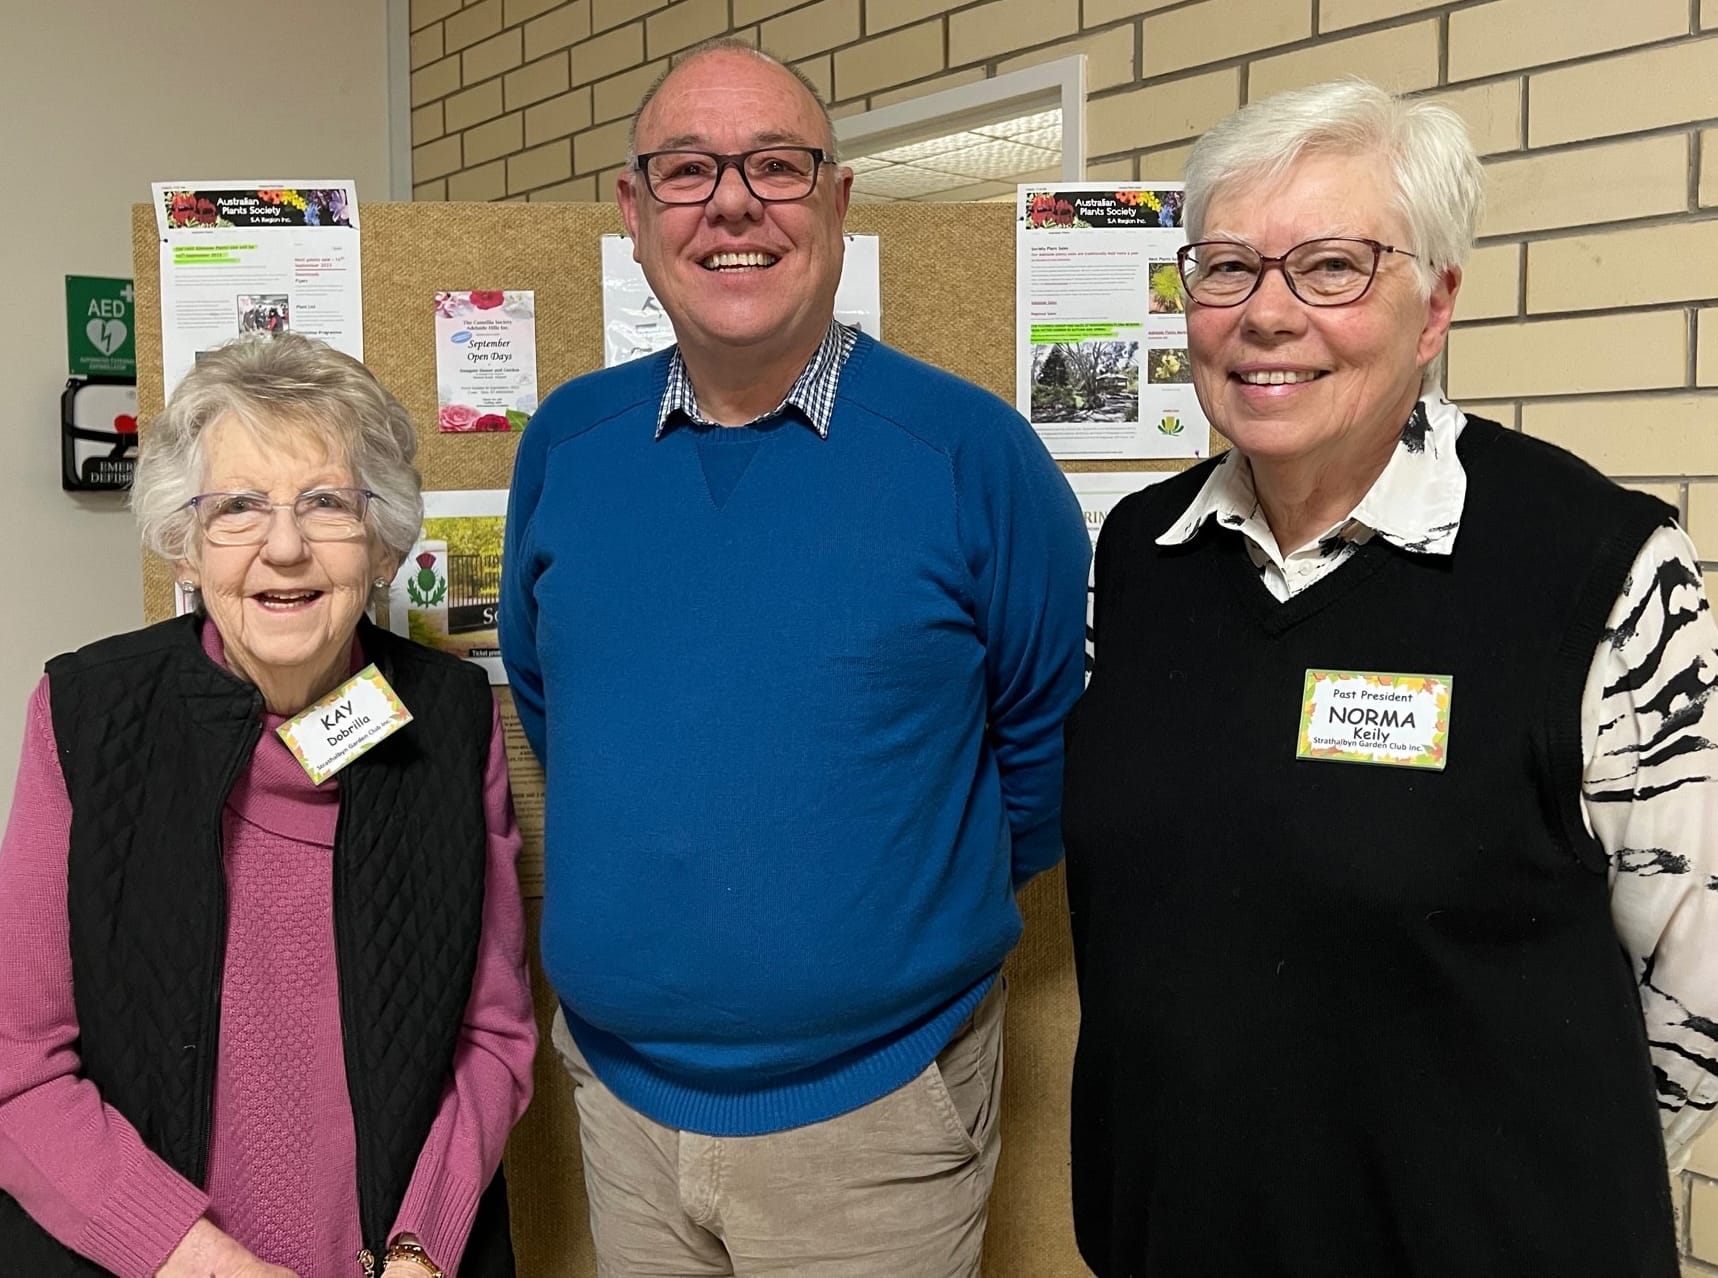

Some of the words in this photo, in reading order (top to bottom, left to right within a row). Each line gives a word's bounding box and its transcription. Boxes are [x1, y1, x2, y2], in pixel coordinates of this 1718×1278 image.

[217, 197, 259, 206] Australian
[1075, 198, 1116, 207] Australian
[222, 206, 247, 215] Plants
[249, 206, 280, 216] Society
[1080, 207, 1104, 216] Plants
[1106, 207, 1136, 217] Society
[88, 299, 125, 318] AED
[468, 338, 511, 351] September
[467, 352, 489, 363] Open
[490, 352, 512, 363] Days
[1333, 688, 1356, 699] Past
[1361, 690, 1413, 702] President
[320, 700, 353, 731] KAY
[1328, 706, 1416, 729] NORMA
[327, 715, 371, 747] Dobrilla
[1353, 727, 1390, 743] Keily
[316, 748, 349, 770] Strathalbyn
[348, 734, 369, 749] Garden
[368, 725, 381, 735] Club
[1313, 736, 1357, 747] Strathalbyn
[1358, 740, 1387, 749] Garden
[1389, 742, 1407, 750] Club
[1408, 744, 1423, 752] Inc.
